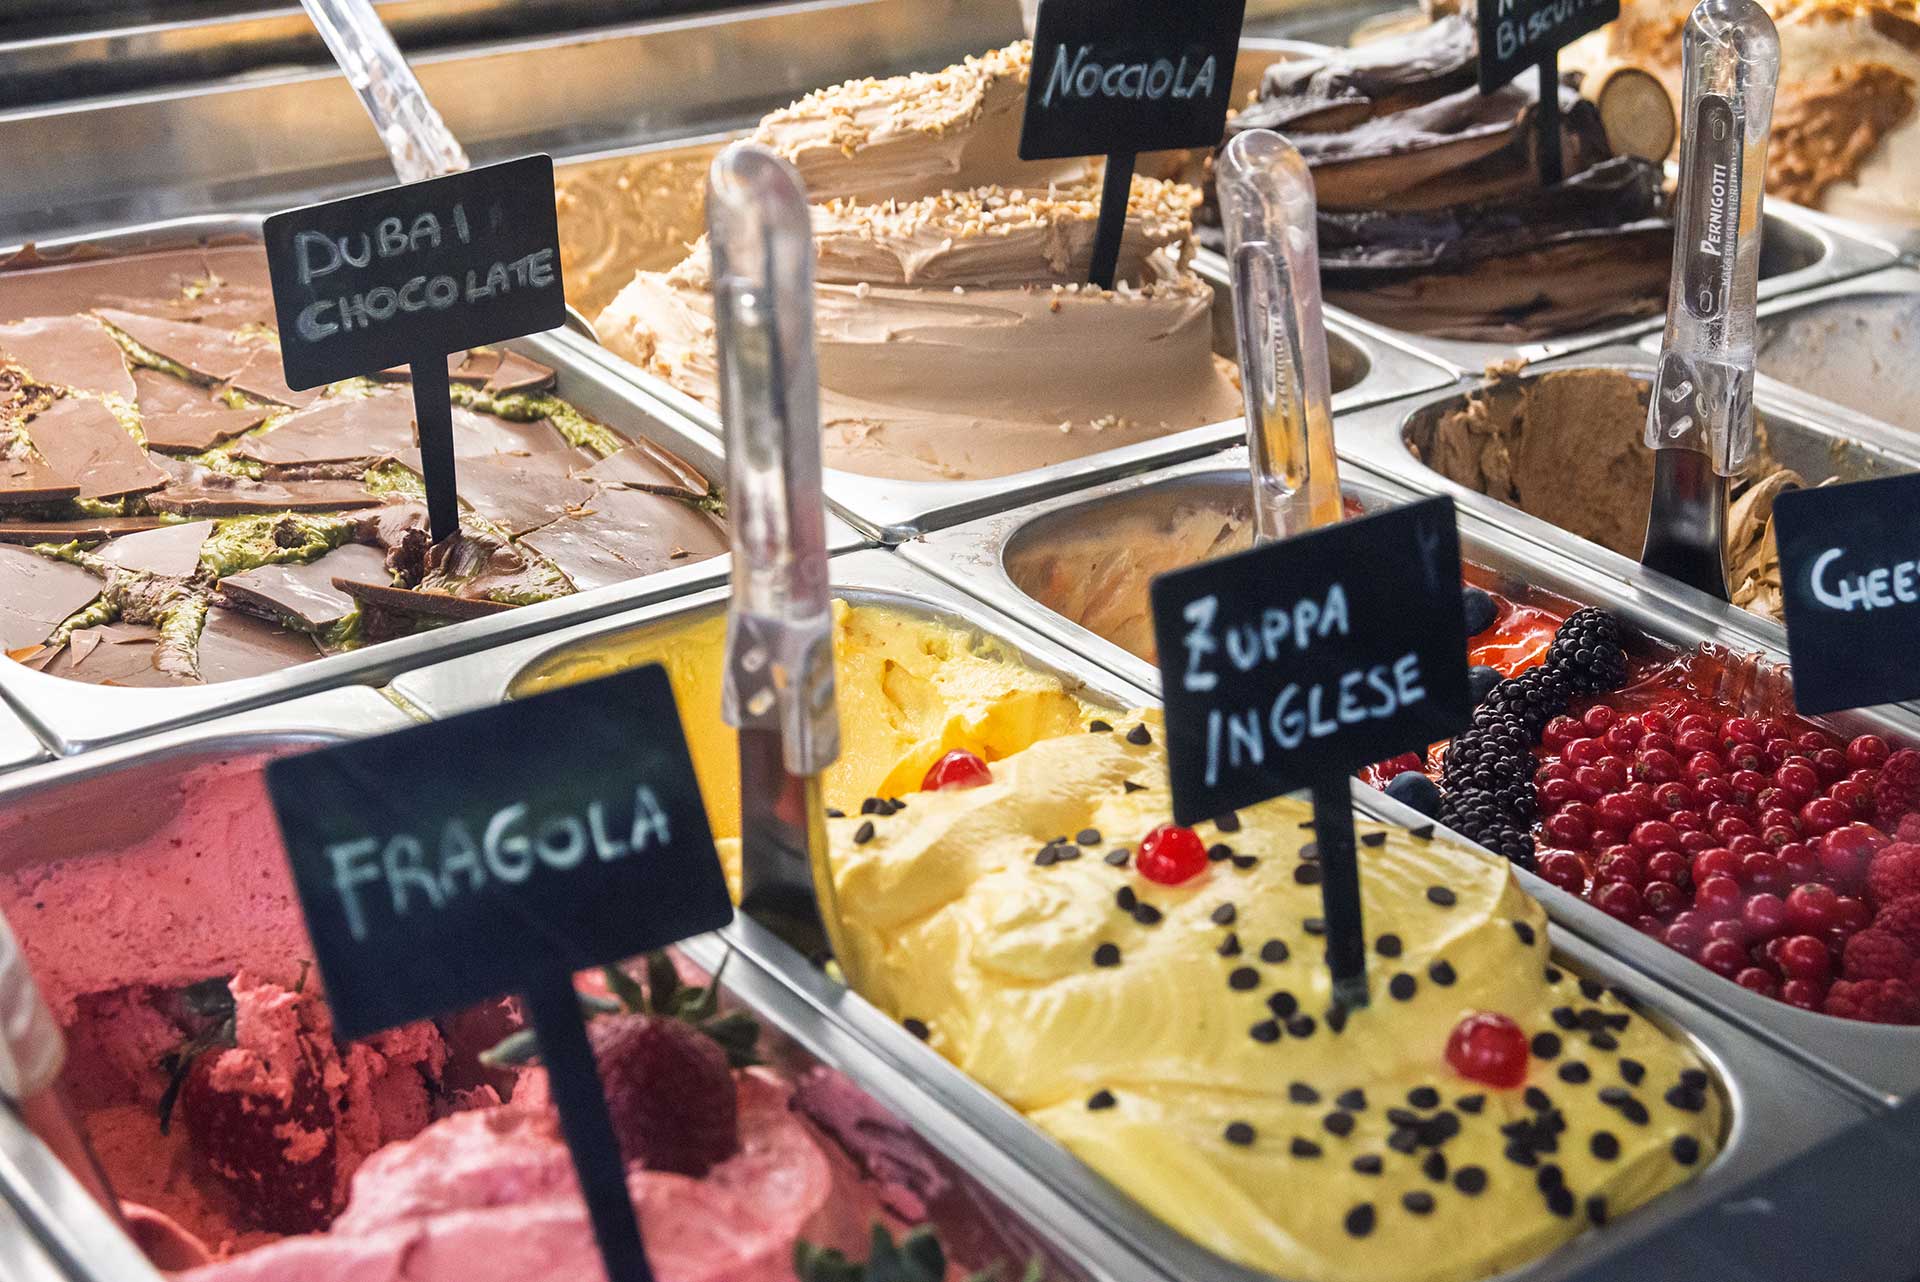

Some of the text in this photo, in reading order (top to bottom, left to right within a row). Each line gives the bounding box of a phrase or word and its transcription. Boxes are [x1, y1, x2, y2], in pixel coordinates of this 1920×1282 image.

[1042, 43, 1217, 107] NOCCIOLA
[295, 203, 470, 286] DUBAI
[1700, 163, 1727, 257] PERNIGOTTI
[296, 248, 555, 342] CHOCOLATE
[1811, 547, 1920, 611] CHEE
[1183, 582, 1349, 692] ZUPPA
[1204, 652, 1426, 788] INGLESE
[325, 784, 672, 942] FRAGOLA
